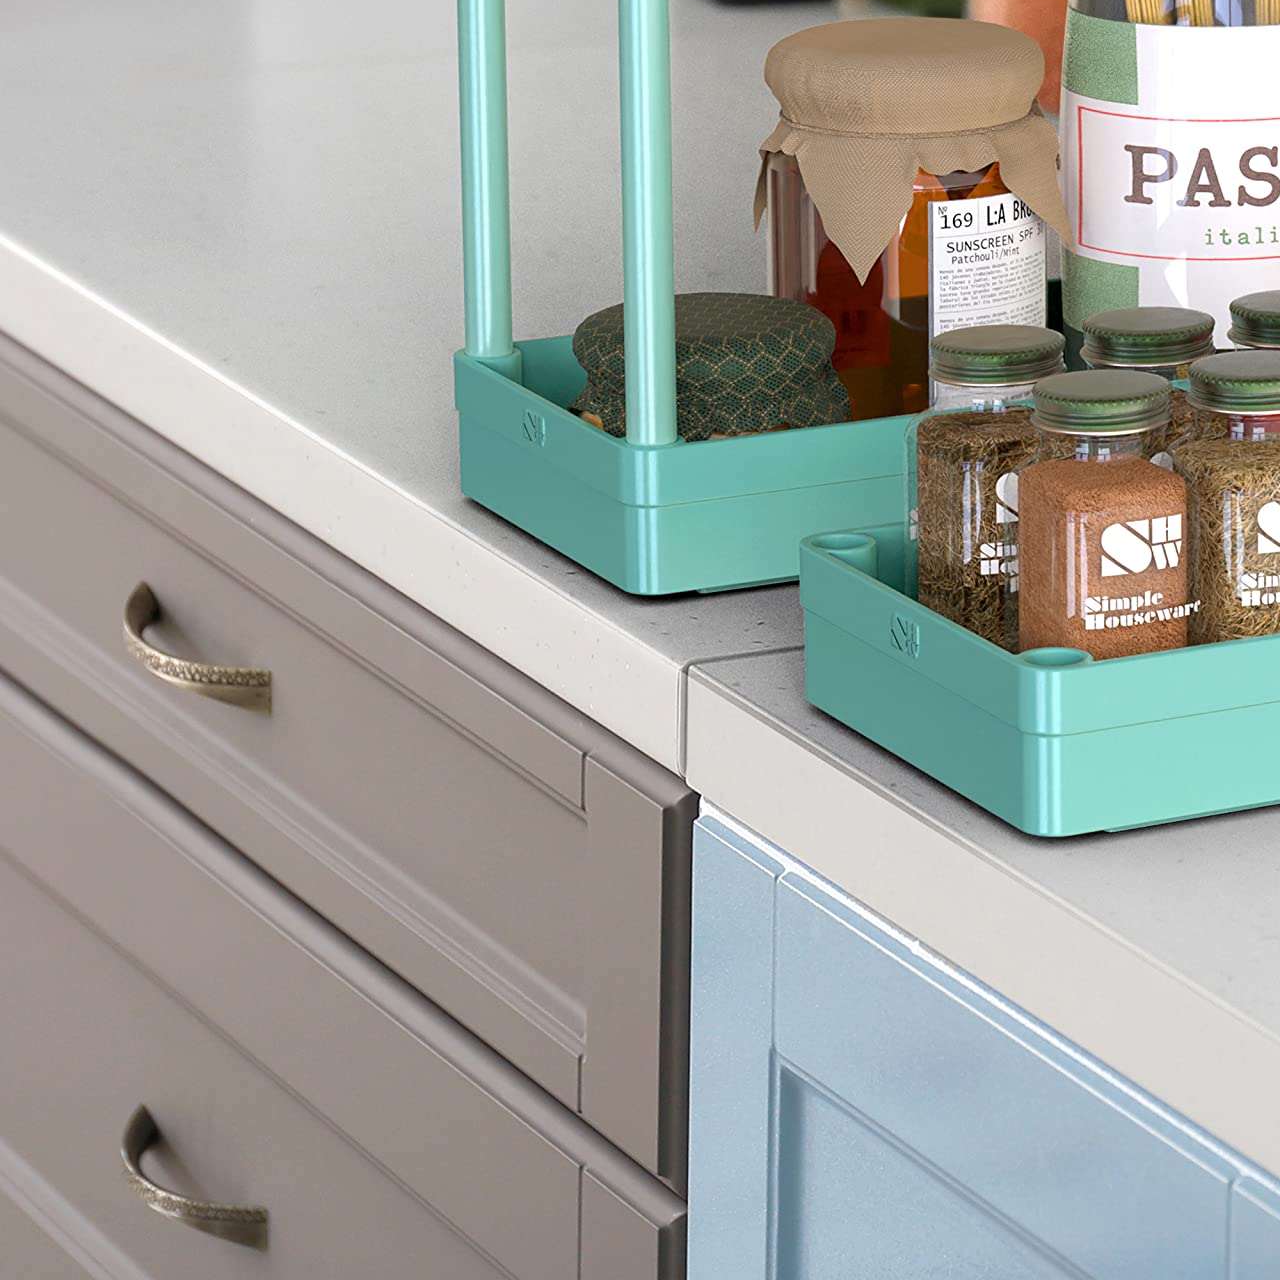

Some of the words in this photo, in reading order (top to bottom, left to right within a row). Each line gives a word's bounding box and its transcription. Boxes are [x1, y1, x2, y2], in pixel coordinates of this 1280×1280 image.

[940, 212, 973, 230] 169
[986, 203, 1006, 226] L:A
[946, 234, 1014, 253] SUNSCREEN
[1018, 227, 1034, 242] SPF
[951, 246, 1020, 265] Patchouli/Mint
[1083, 590, 1164, 614] Simple
